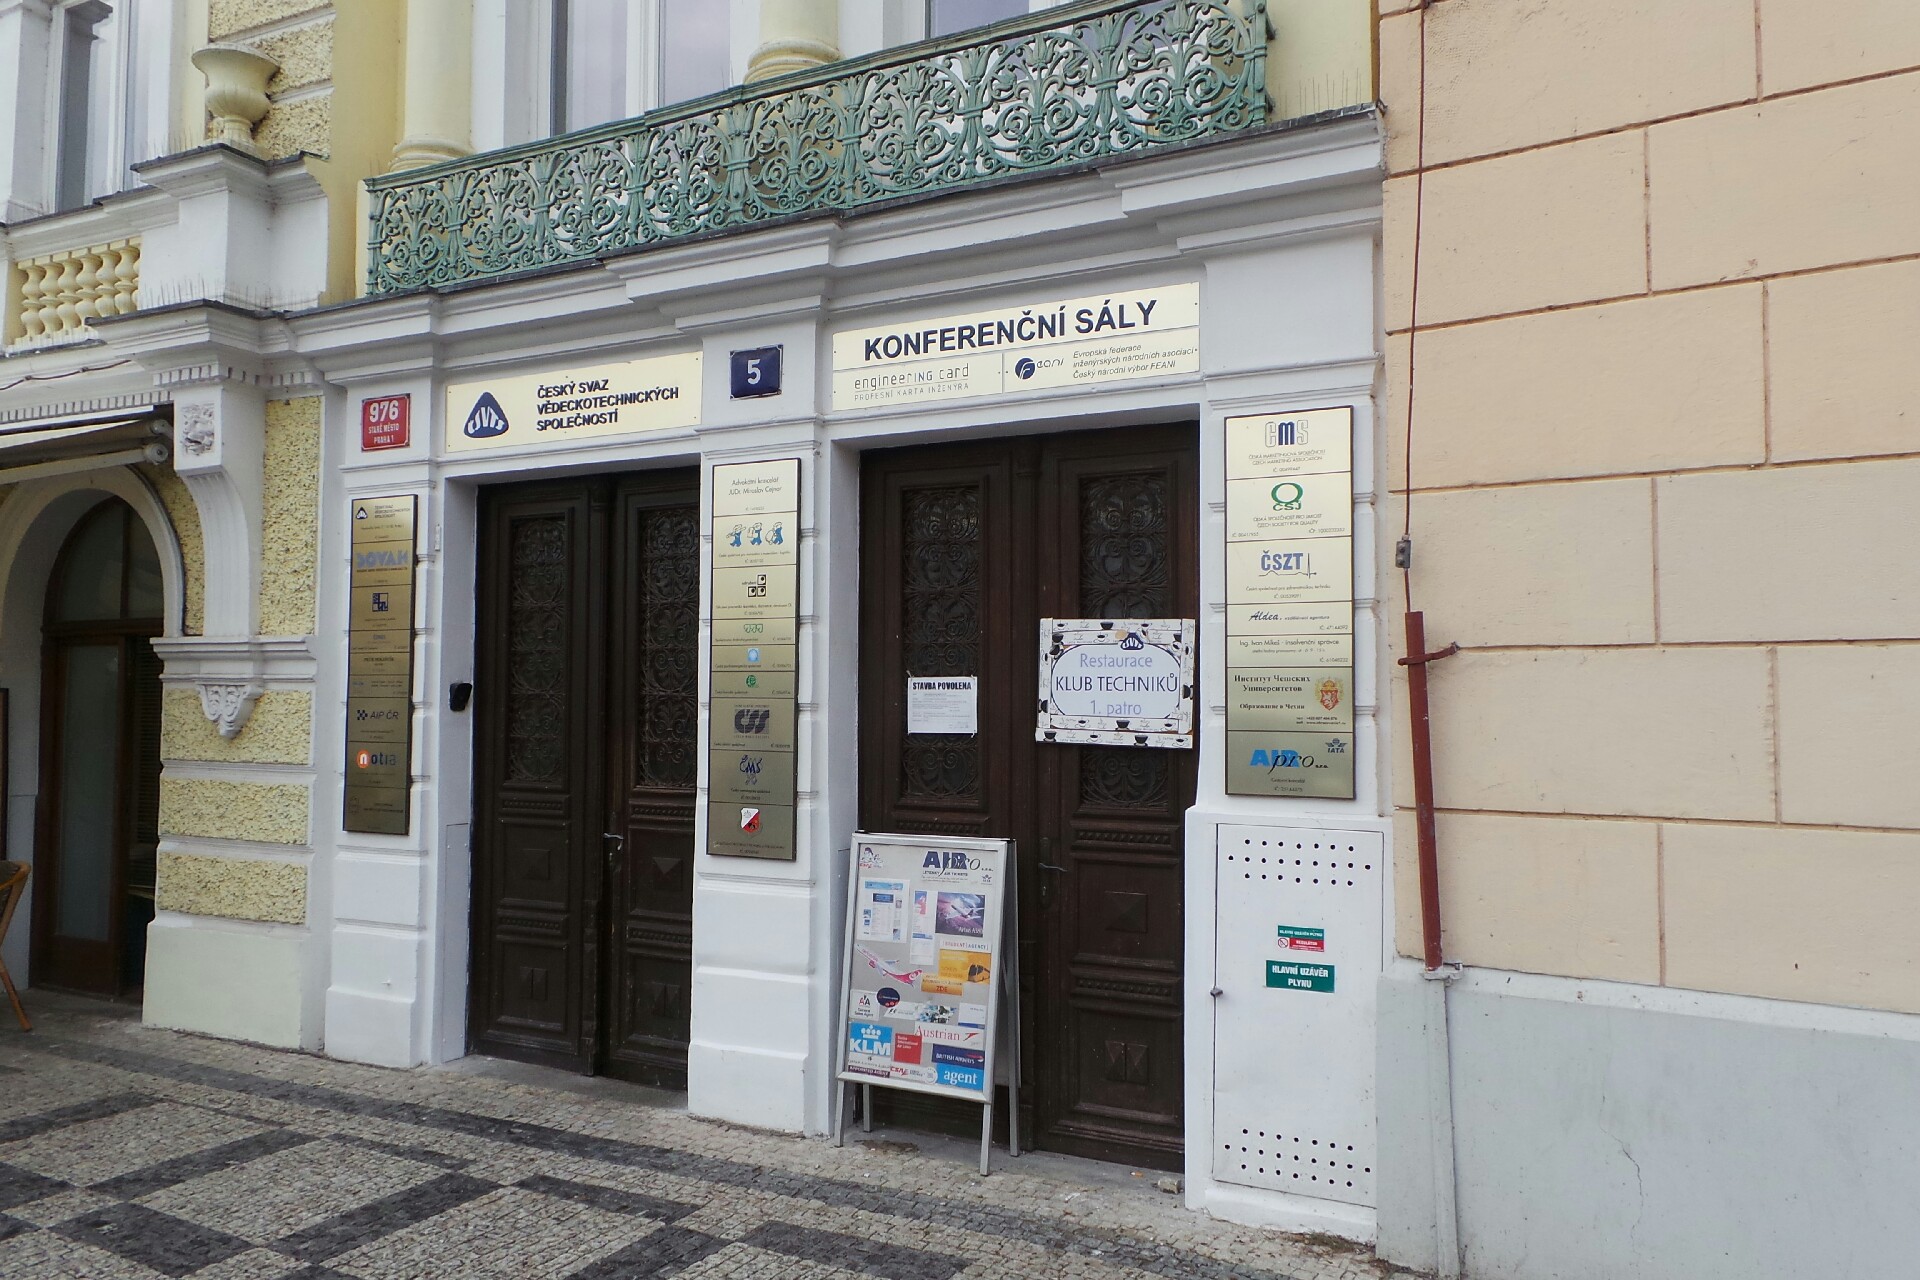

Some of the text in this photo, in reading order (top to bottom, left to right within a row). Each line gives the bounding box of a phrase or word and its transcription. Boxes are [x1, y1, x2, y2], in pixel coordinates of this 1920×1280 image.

[864, 299, 1157, 361] KONFERENČNÍ SÁLY
[1073, 345, 1141, 359] Evropská federace
[1073, 356, 1120, 368] inženýrských
[1122, 352, 1159, 362] národních
[748, 359, 760, 384] 5
[940, 363, 969, 379] card
[1073, 370, 1095, 379] Český
[1127, 364, 1149, 374] výbor
[1150, 360, 1176, 370] FEANI
[537, 379, 609, 399] ČESKÝ SVAZ
[855, 391, 893, 401] PROFESNÍ
[537, 387, 679, 415] VĚDECKOTECHNICKÝCH
[370, 400, 399, 422] 976
[536, 409, 618, 431] SPOLEČNOSTÍ
[368, 422, 399, 434] STARÉ MĚSTO
[374, 436, 390, 444] PRAHA
[1261, 550, 1303, 571] ČSZT
[1080, 654, 1152, 668] Restaurace
[913, 682, 972, 690] STAVBA POVOLENA
[1056, 673, 1178, 691] KLUB TECHNIKŮ
[1234, 675, 1271, 683] Институт
[1243, 685, 1302, 693] Университетов
[370, 709, 399, 719] AIP ČR
[1090, 700, 1142, 716] 1. patro
[1240, 703, 1278, 711] Образование
[1272, 965, 1328, 977] HLAVNÍ UZÁVĚR
[1288, 978, 1312, 988] PLYNU
[915, 1026, 960, 1041] Austrian
[850, 1038, 891, 1056] KLM
[944, 1070, 977, 1085] agent
